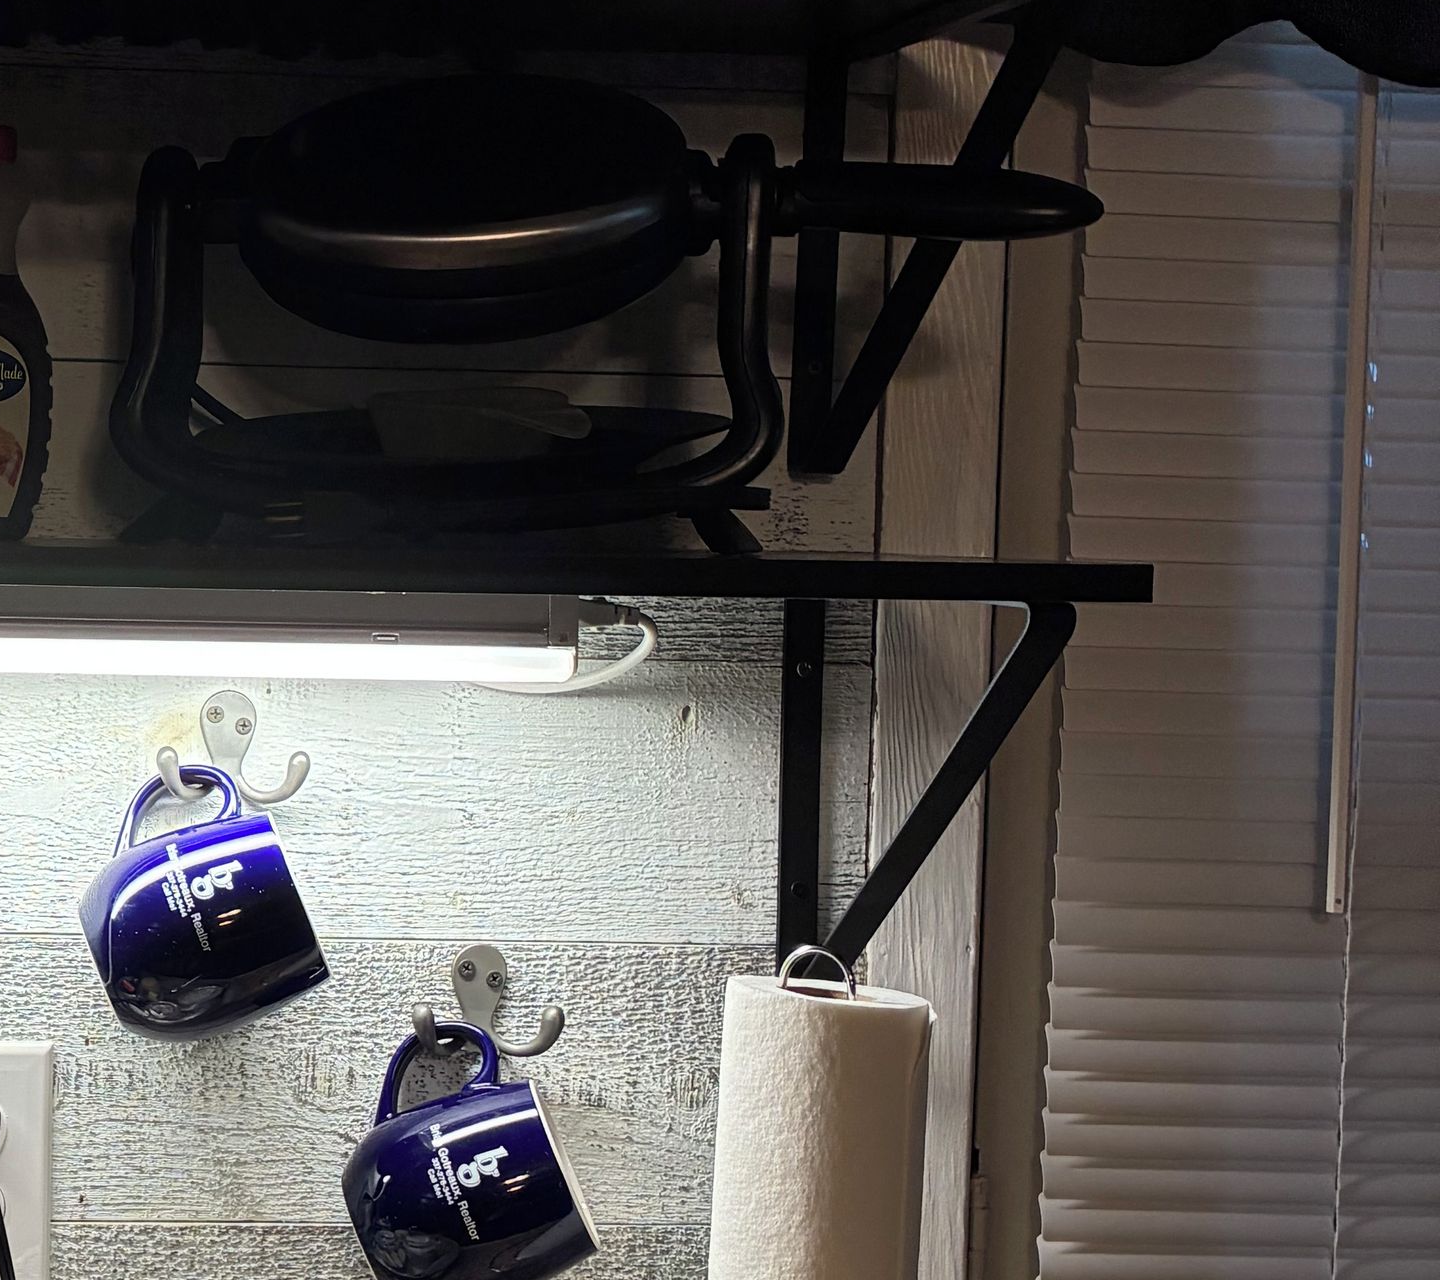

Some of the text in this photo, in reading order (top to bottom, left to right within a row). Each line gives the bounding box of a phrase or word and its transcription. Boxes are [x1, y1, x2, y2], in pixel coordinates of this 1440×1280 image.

[161, 881, 173, 898] Call
[190, 912, 211, 952] Realtor
[427, 1167, 444, 1200] Call Me!
[437, 1147, 463, 1201] Gotreaux,
[457, 1200, 480, 1241] Realtor
